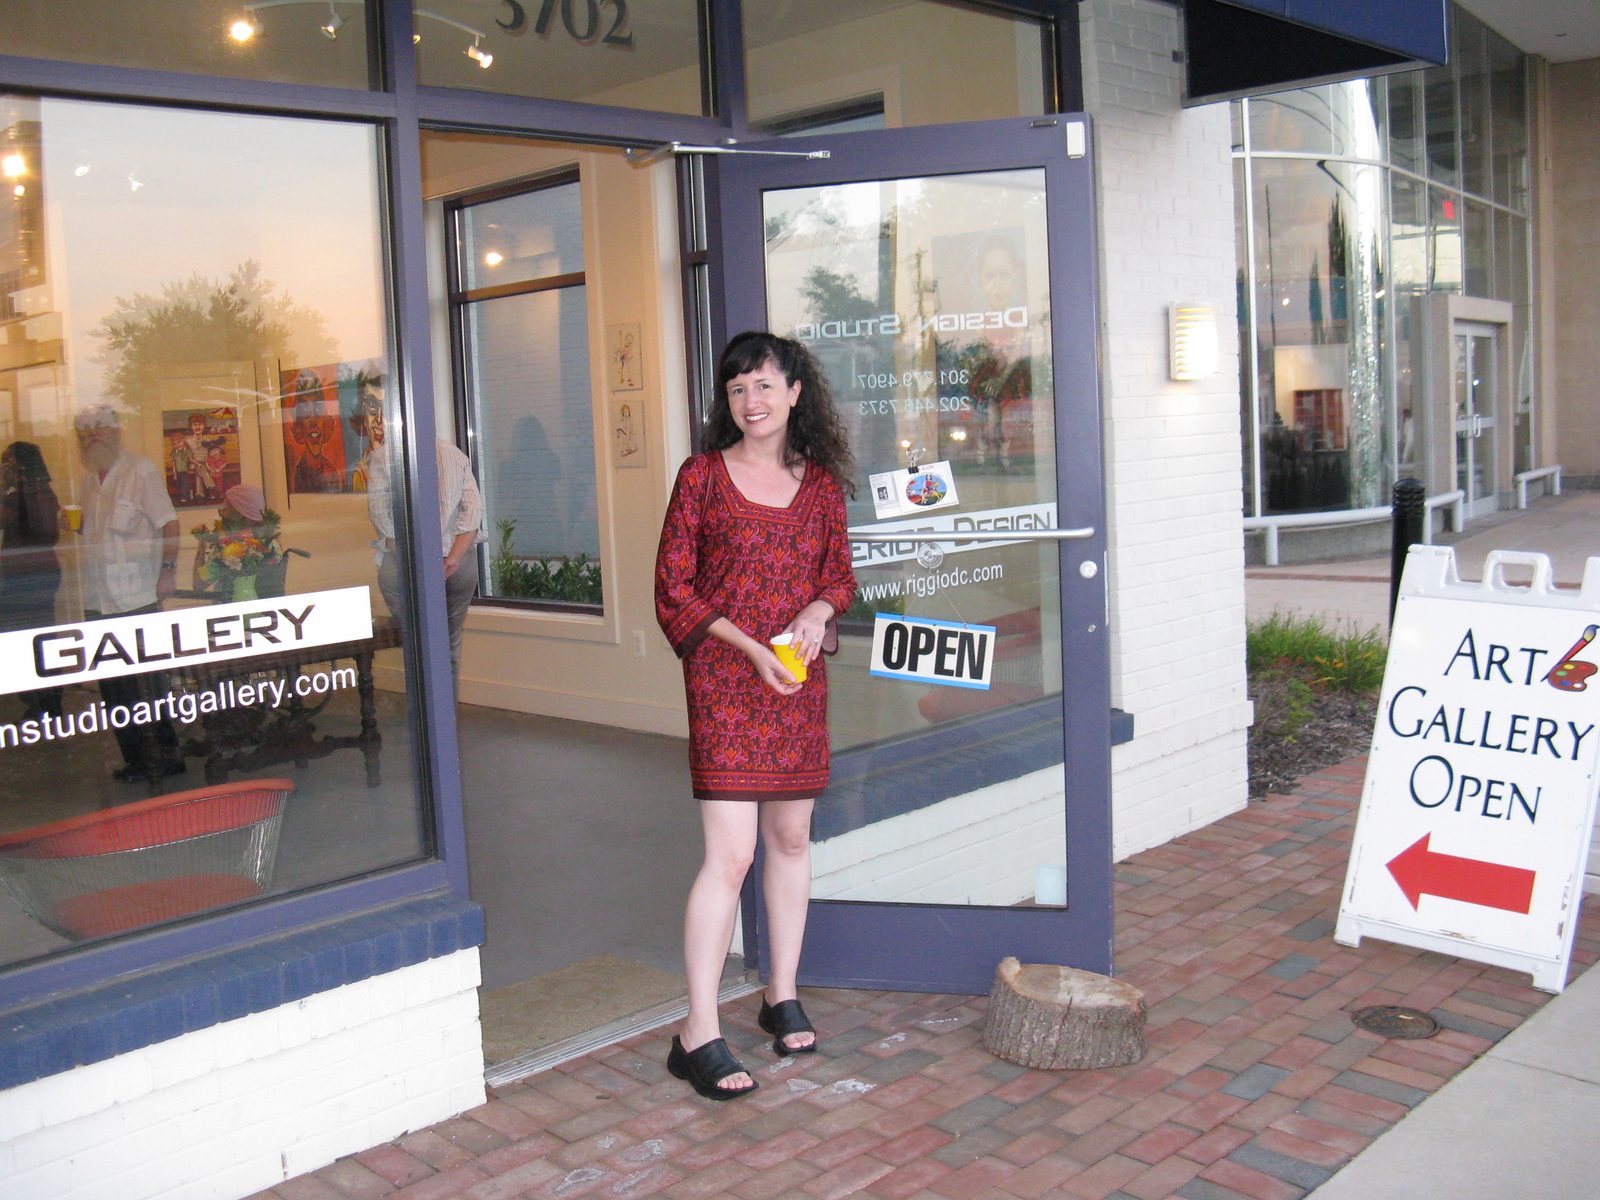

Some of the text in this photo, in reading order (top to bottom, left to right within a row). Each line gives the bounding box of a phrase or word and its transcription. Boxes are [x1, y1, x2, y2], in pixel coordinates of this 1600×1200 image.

[861, 563, 1003, 602] www.riggiodc.com
[32, 604, 315, 678] GALLERY
[882, 622, 987, 680] OPEN
[1443, 627, 1548, 686] ART
[0, 668, 356, 749] nstudioartgallery.com
[1388, 686, 1594, 761] GALLERY
[1409, 755, 1542, 824] OPEN
